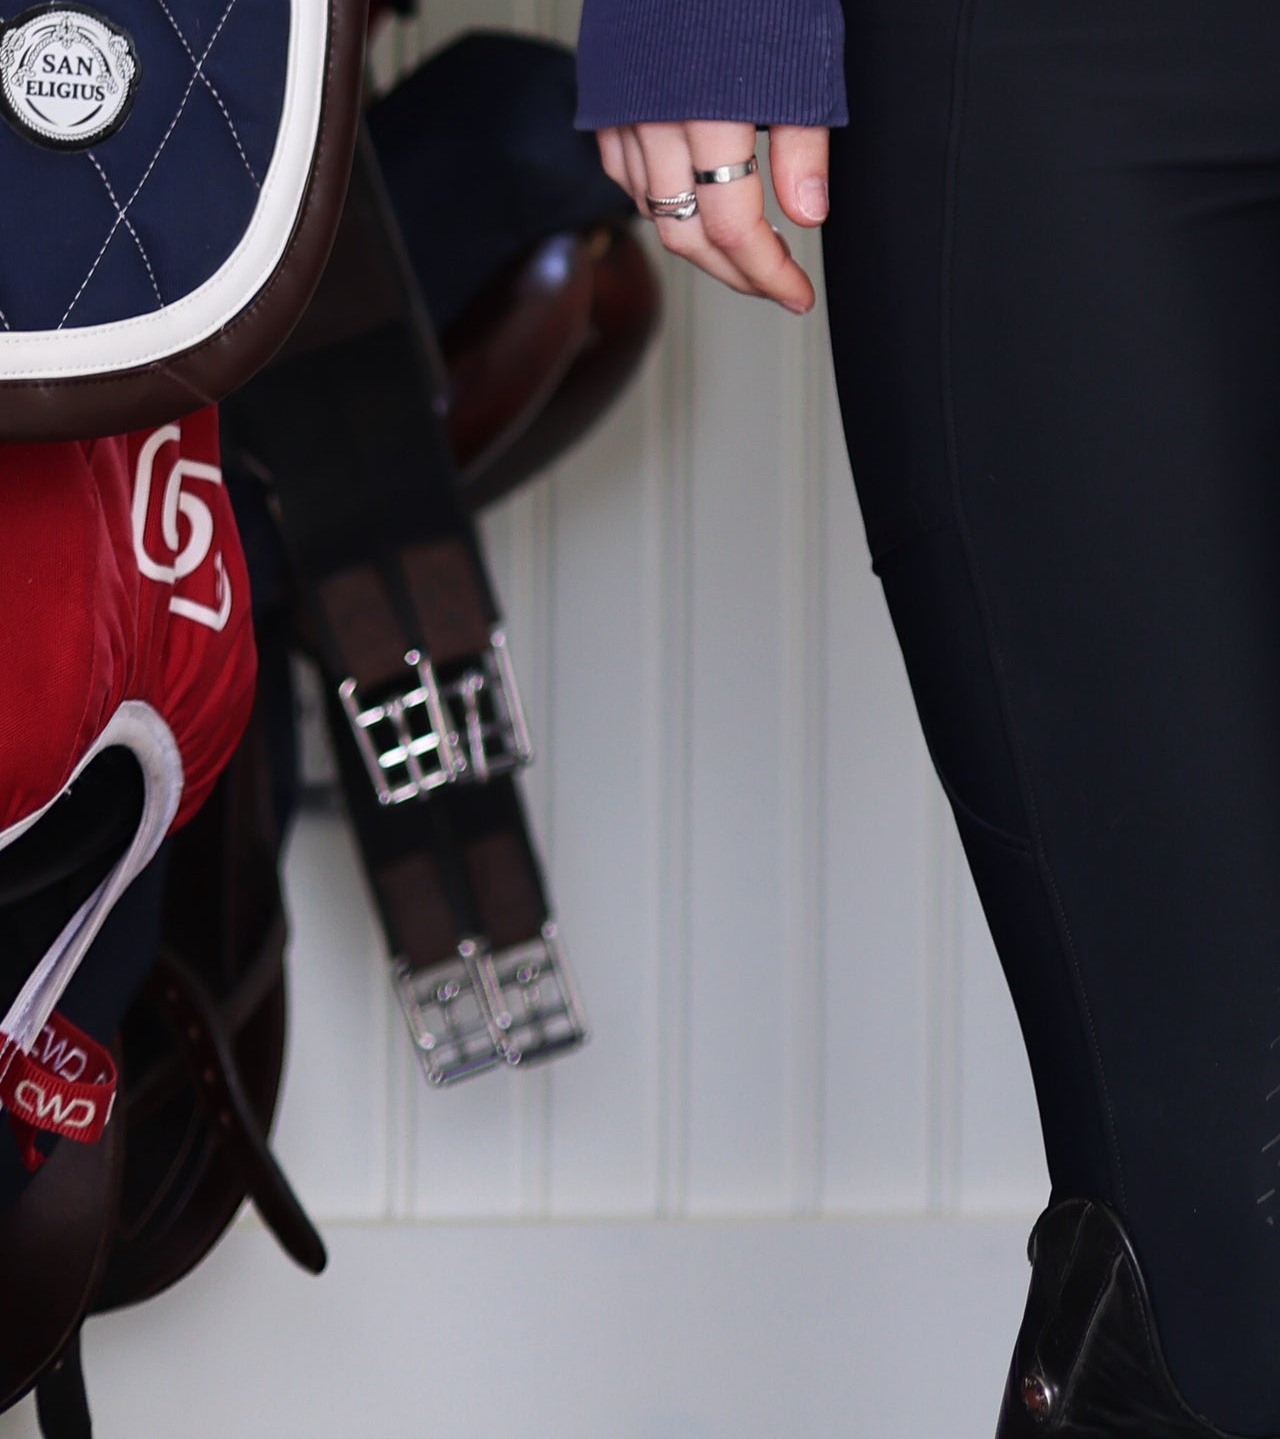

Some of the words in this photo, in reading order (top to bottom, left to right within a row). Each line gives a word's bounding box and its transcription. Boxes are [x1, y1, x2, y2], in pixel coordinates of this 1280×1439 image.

[42, 54, 93, 76] SAN
[25, 80, 105, 102] ELIGIUS
[30, 1024, 88, 1082] WD
[14, 1079, 96, 1128] CWD
